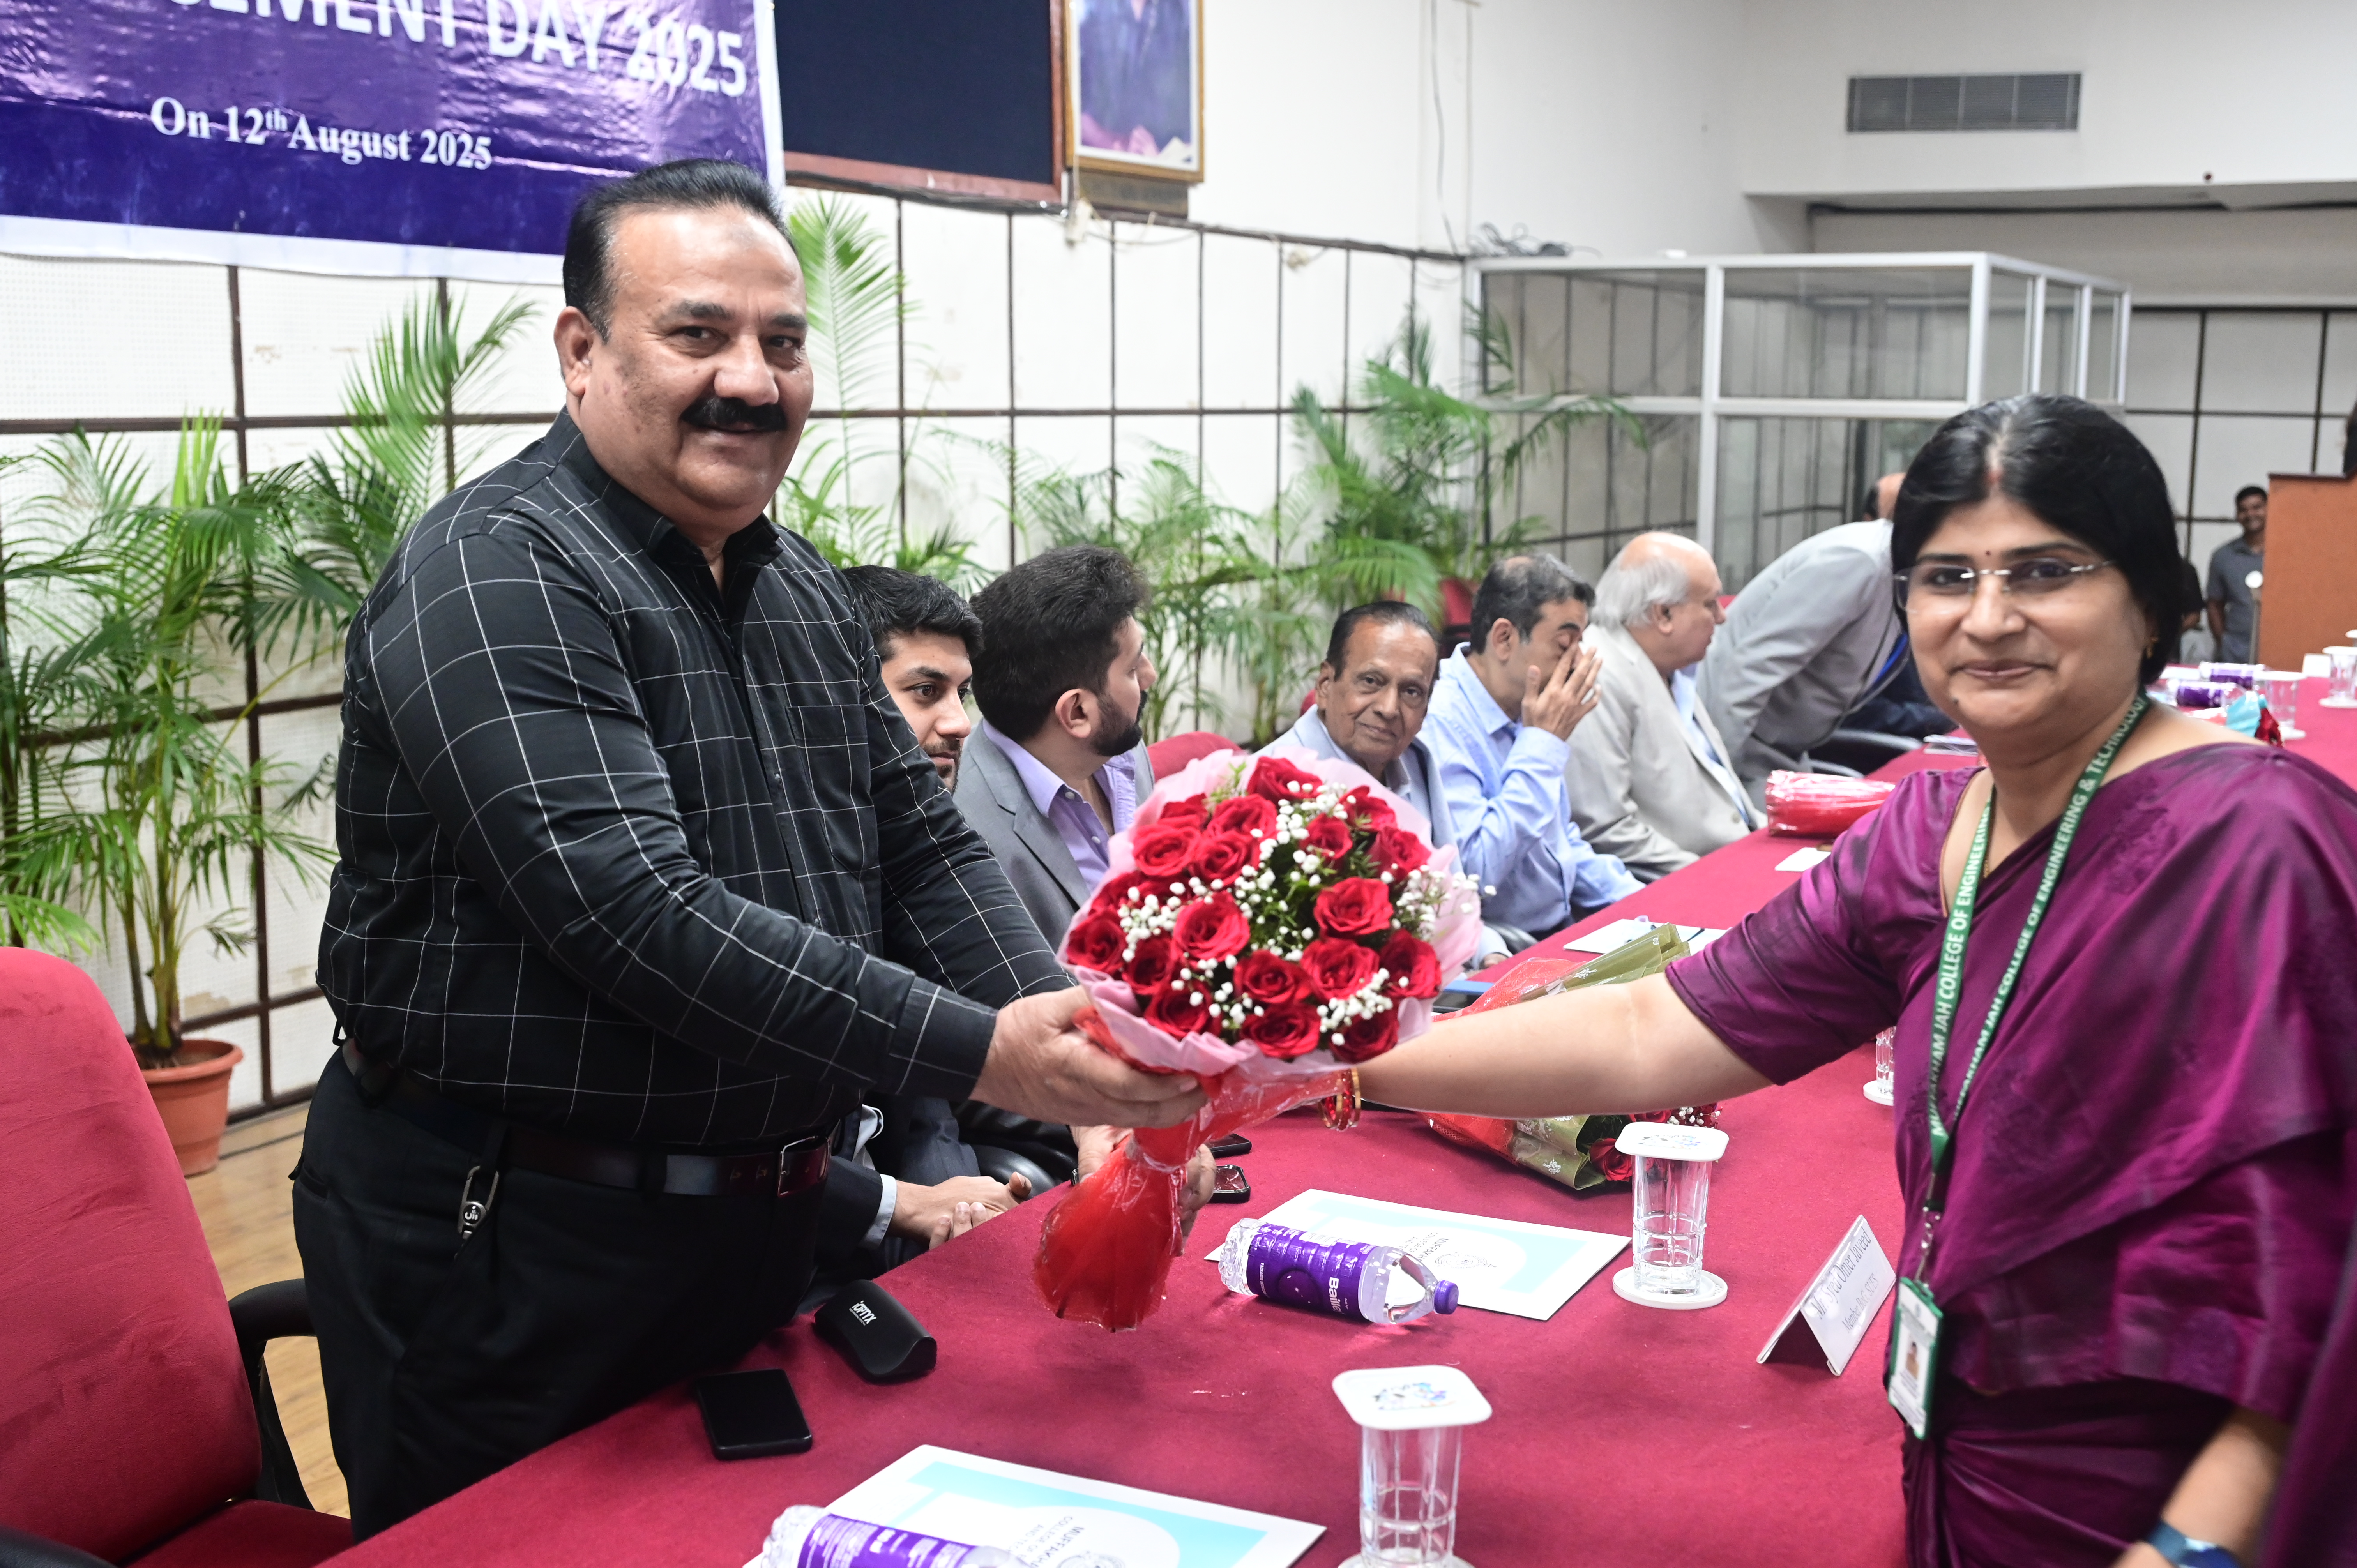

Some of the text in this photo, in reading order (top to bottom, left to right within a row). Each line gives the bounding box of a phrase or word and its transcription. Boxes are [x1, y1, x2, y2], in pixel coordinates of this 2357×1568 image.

[486, 0, 607, 72] DAY
[625, 11, 747, 97] 2025
[151, 97, 492, 170] On 12th August 2025
[1951, 908, 1970, 931] OF
[1985, 998, 2003, 1029] JAH
[1998, 927, 2032, 996] COLLEGE
[2027, 904, 2042, 925] OF
[2037, 794, 2088, 902] ENGINEERING
[2078, 779, 2096, 792] &
[1938, 933, 1964, 1001] COLLEGE
[1933, 1001, 1953, 1033] JAH
[1414, 1232, 1438, 1247] COLLEGE
[1822, 1271, 1842, 1304] Syed
[1833, 1254, 1856, 1282] Omer
[1850, 1227, 1871, 1263] Javeed
[1842, 1306, 1861, 1333] Member
[1865, 1273, 1879, 1297] SUES
[1035, 1516, 1073, 1543] COLLEGE
